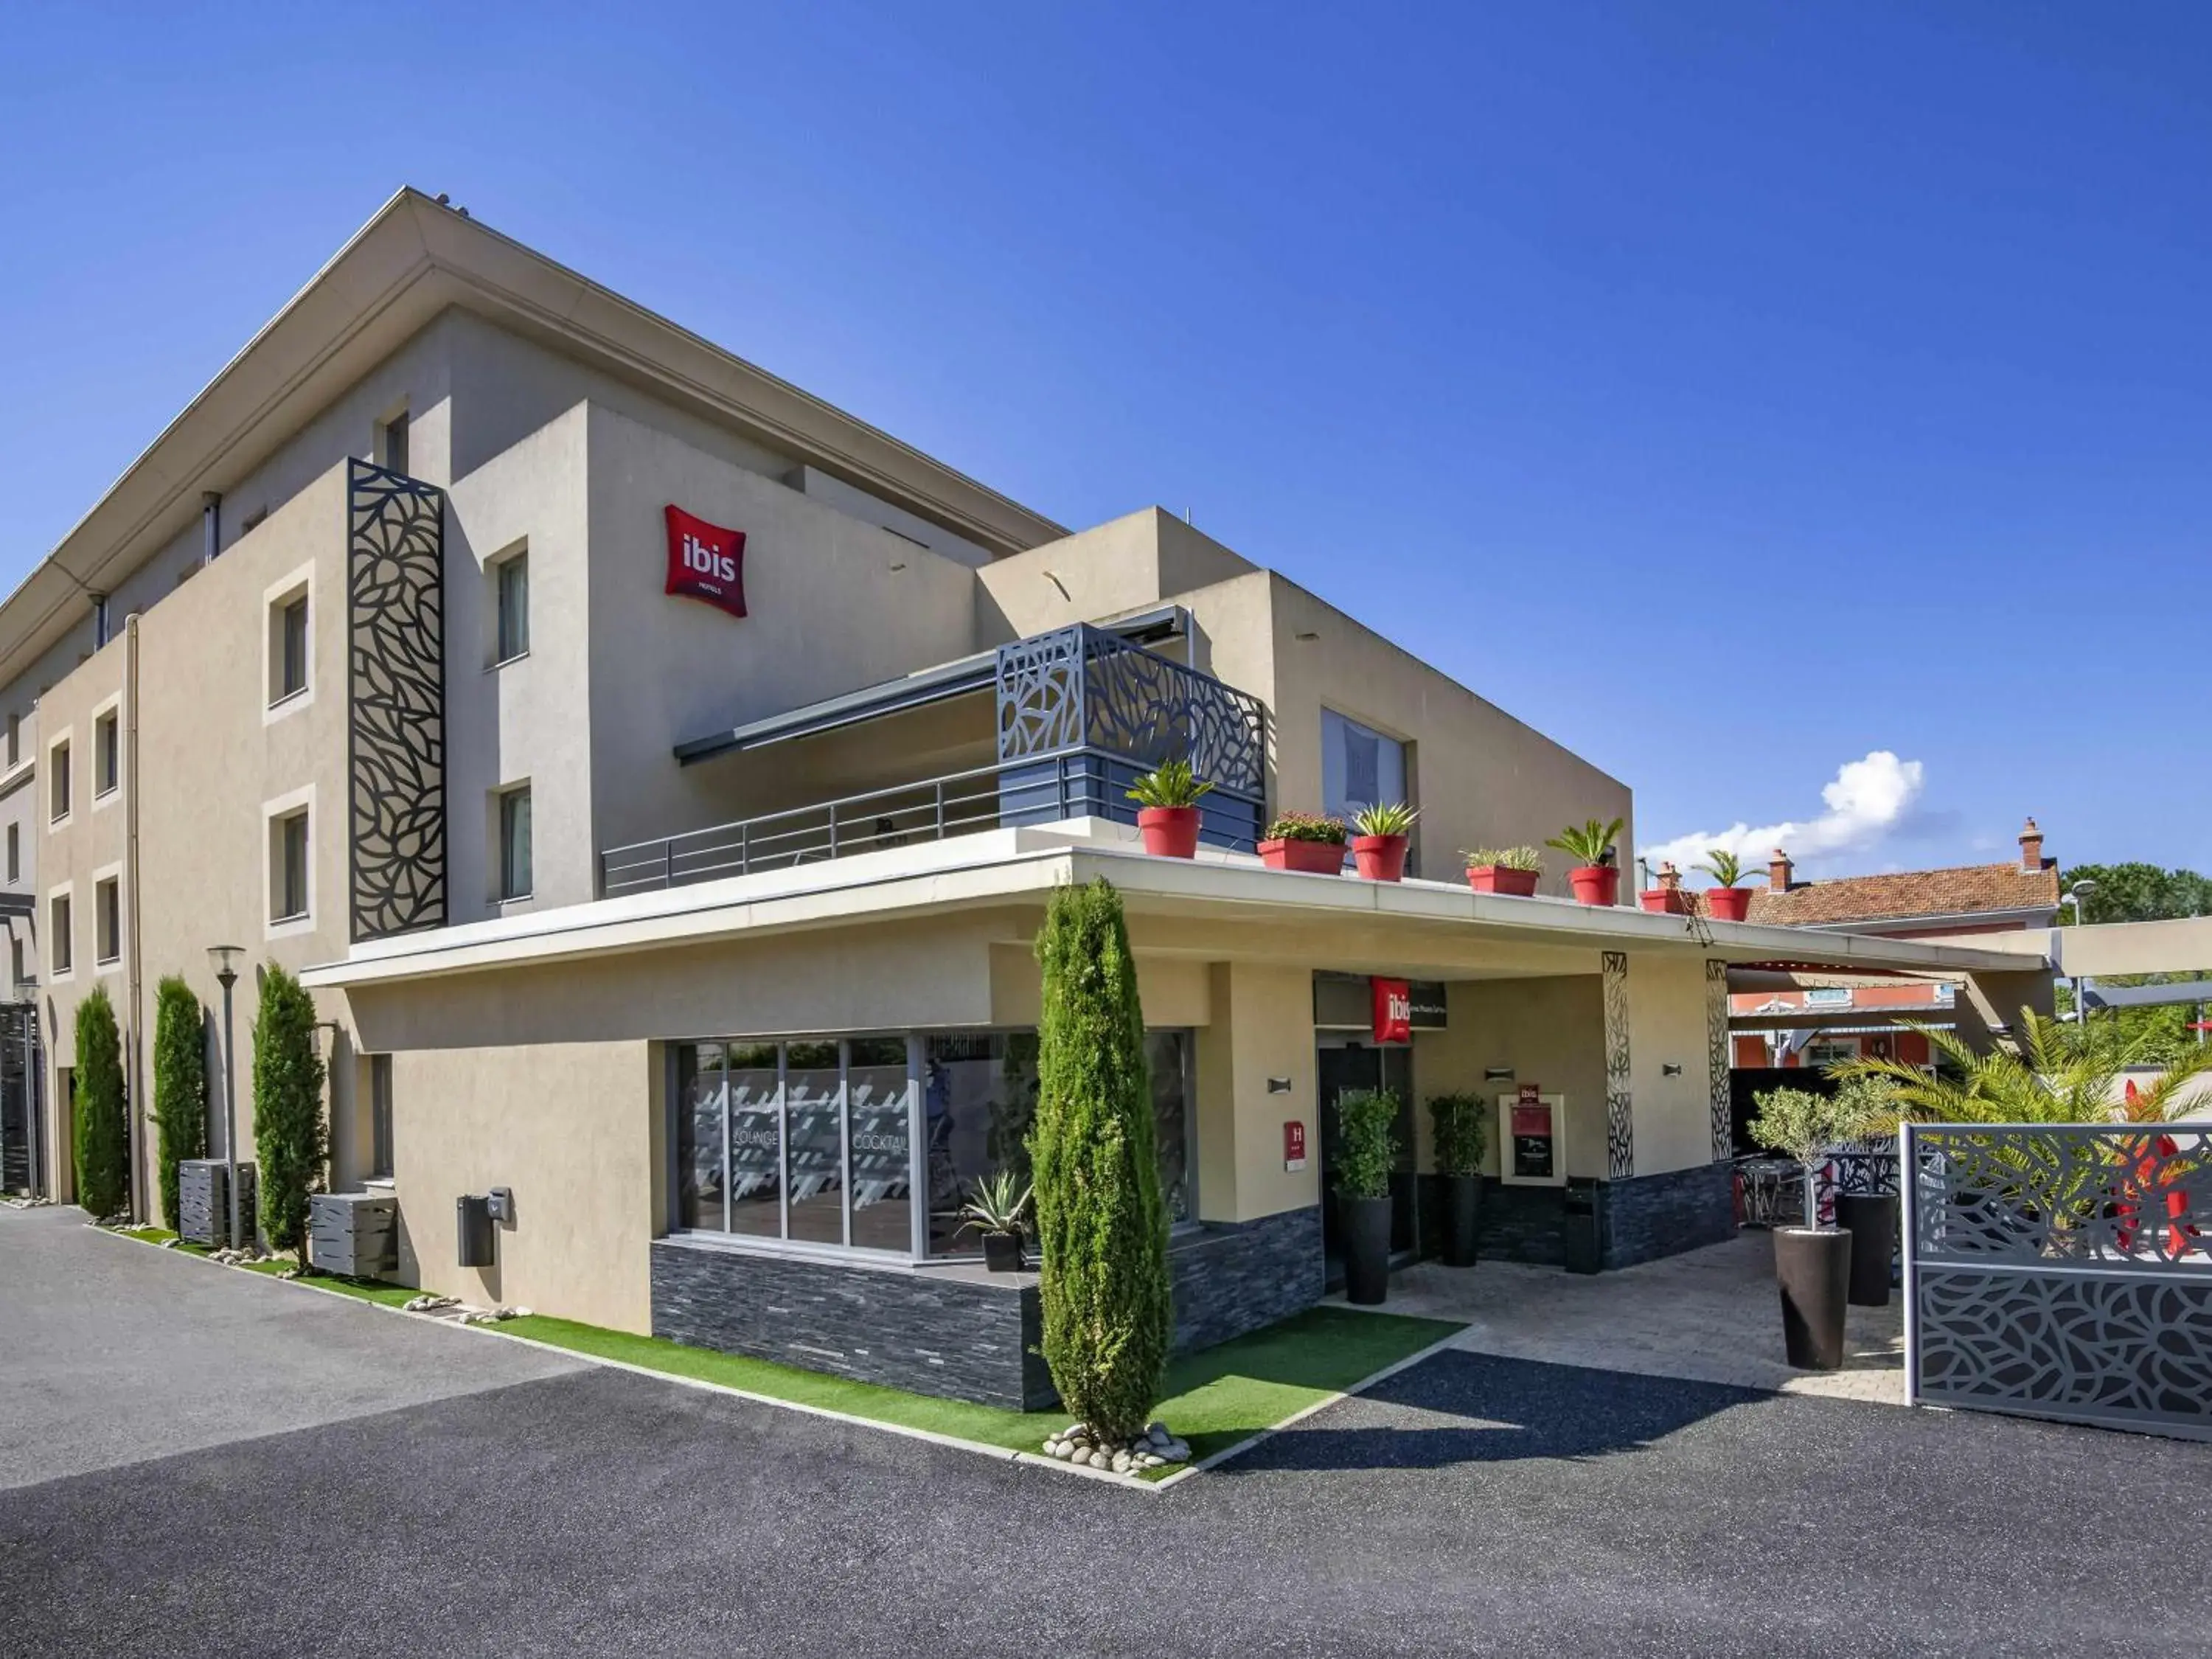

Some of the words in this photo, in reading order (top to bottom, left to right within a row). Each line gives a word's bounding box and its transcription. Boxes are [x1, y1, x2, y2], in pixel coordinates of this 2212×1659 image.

[684, 533, 735, 582] ibis
[1389, 994, 1411, 1020] ibis
[734, 1130, 779, 1145] LOUNGE
[853, 1133, 909, 1151] COCKTAIL
